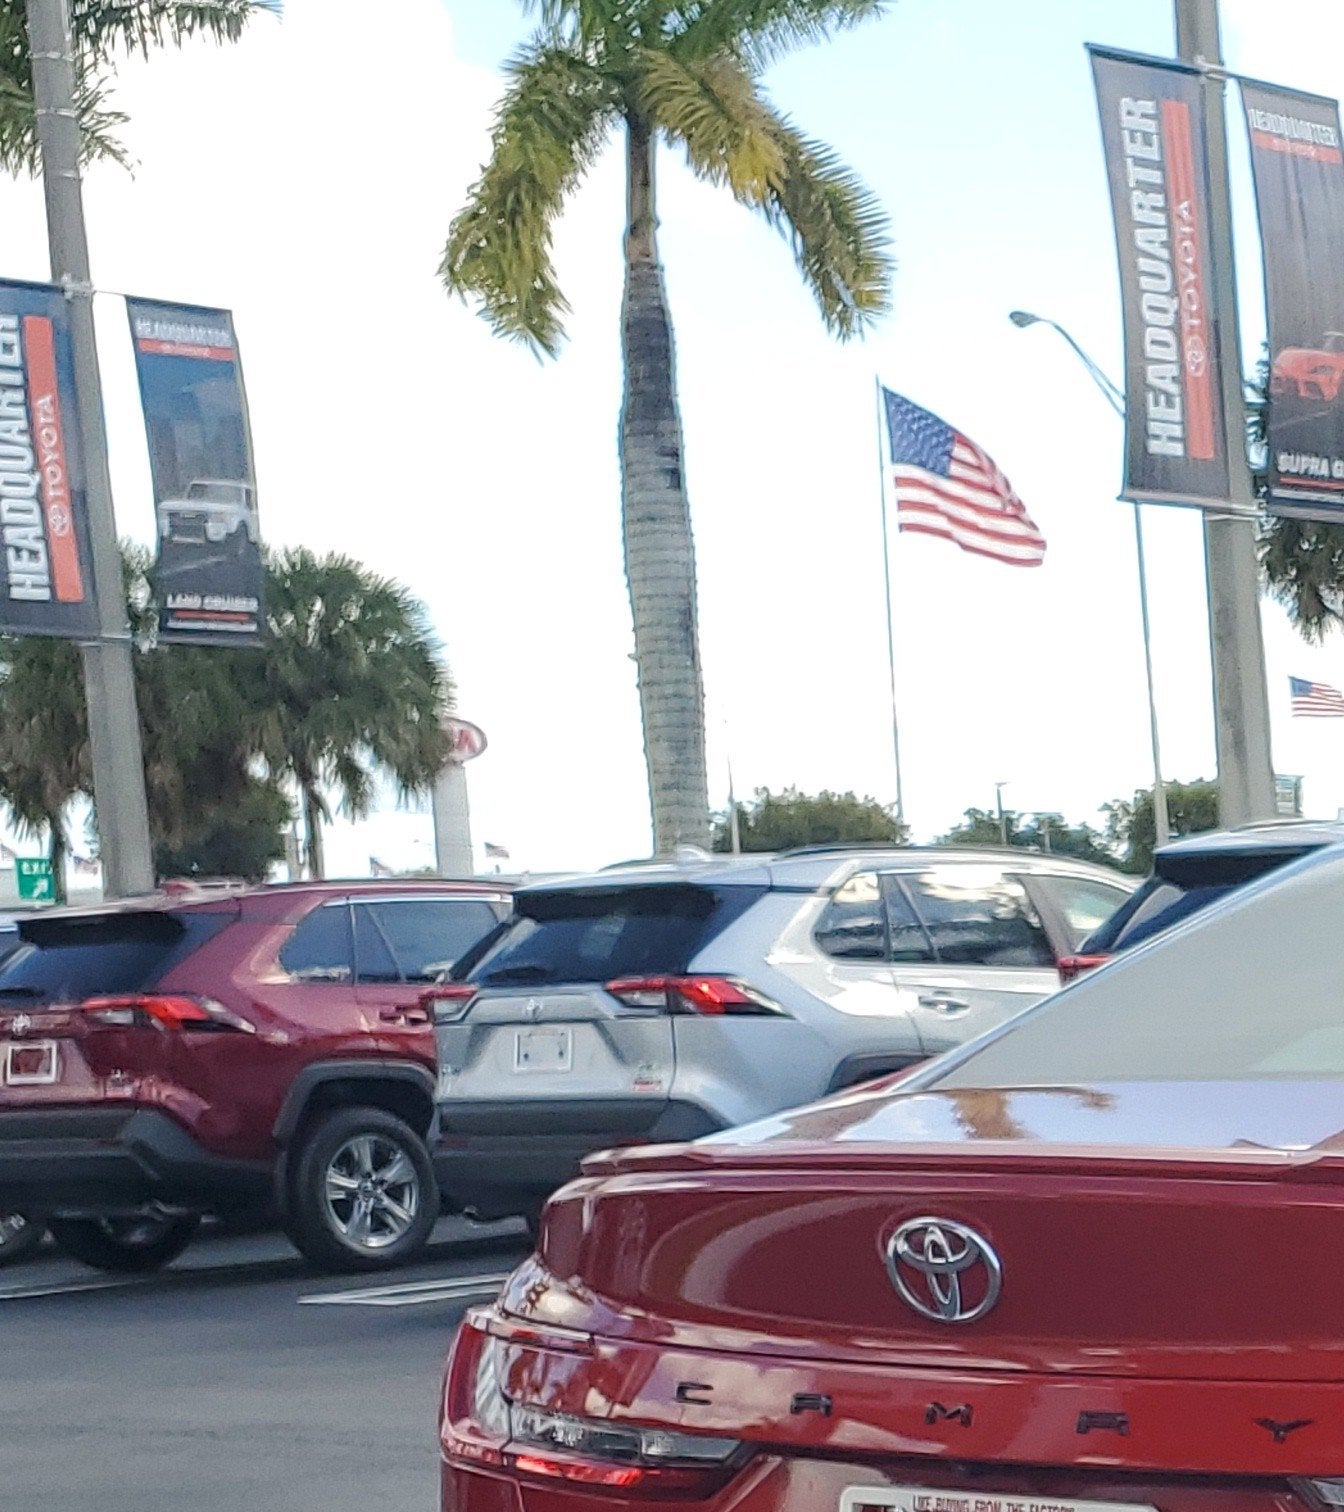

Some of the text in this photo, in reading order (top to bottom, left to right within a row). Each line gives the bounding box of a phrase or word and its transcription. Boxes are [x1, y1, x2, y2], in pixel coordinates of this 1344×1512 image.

[1119, 97, 1185, 456] HEADQUARTER
[1176, 200, 1201, 328] TOYOTA
[36, 393, 64, 497] TOYOTA
[1277, 450, 1329, 476] SUPRA
[675, 1381, 1314, 1443] CAMRY
